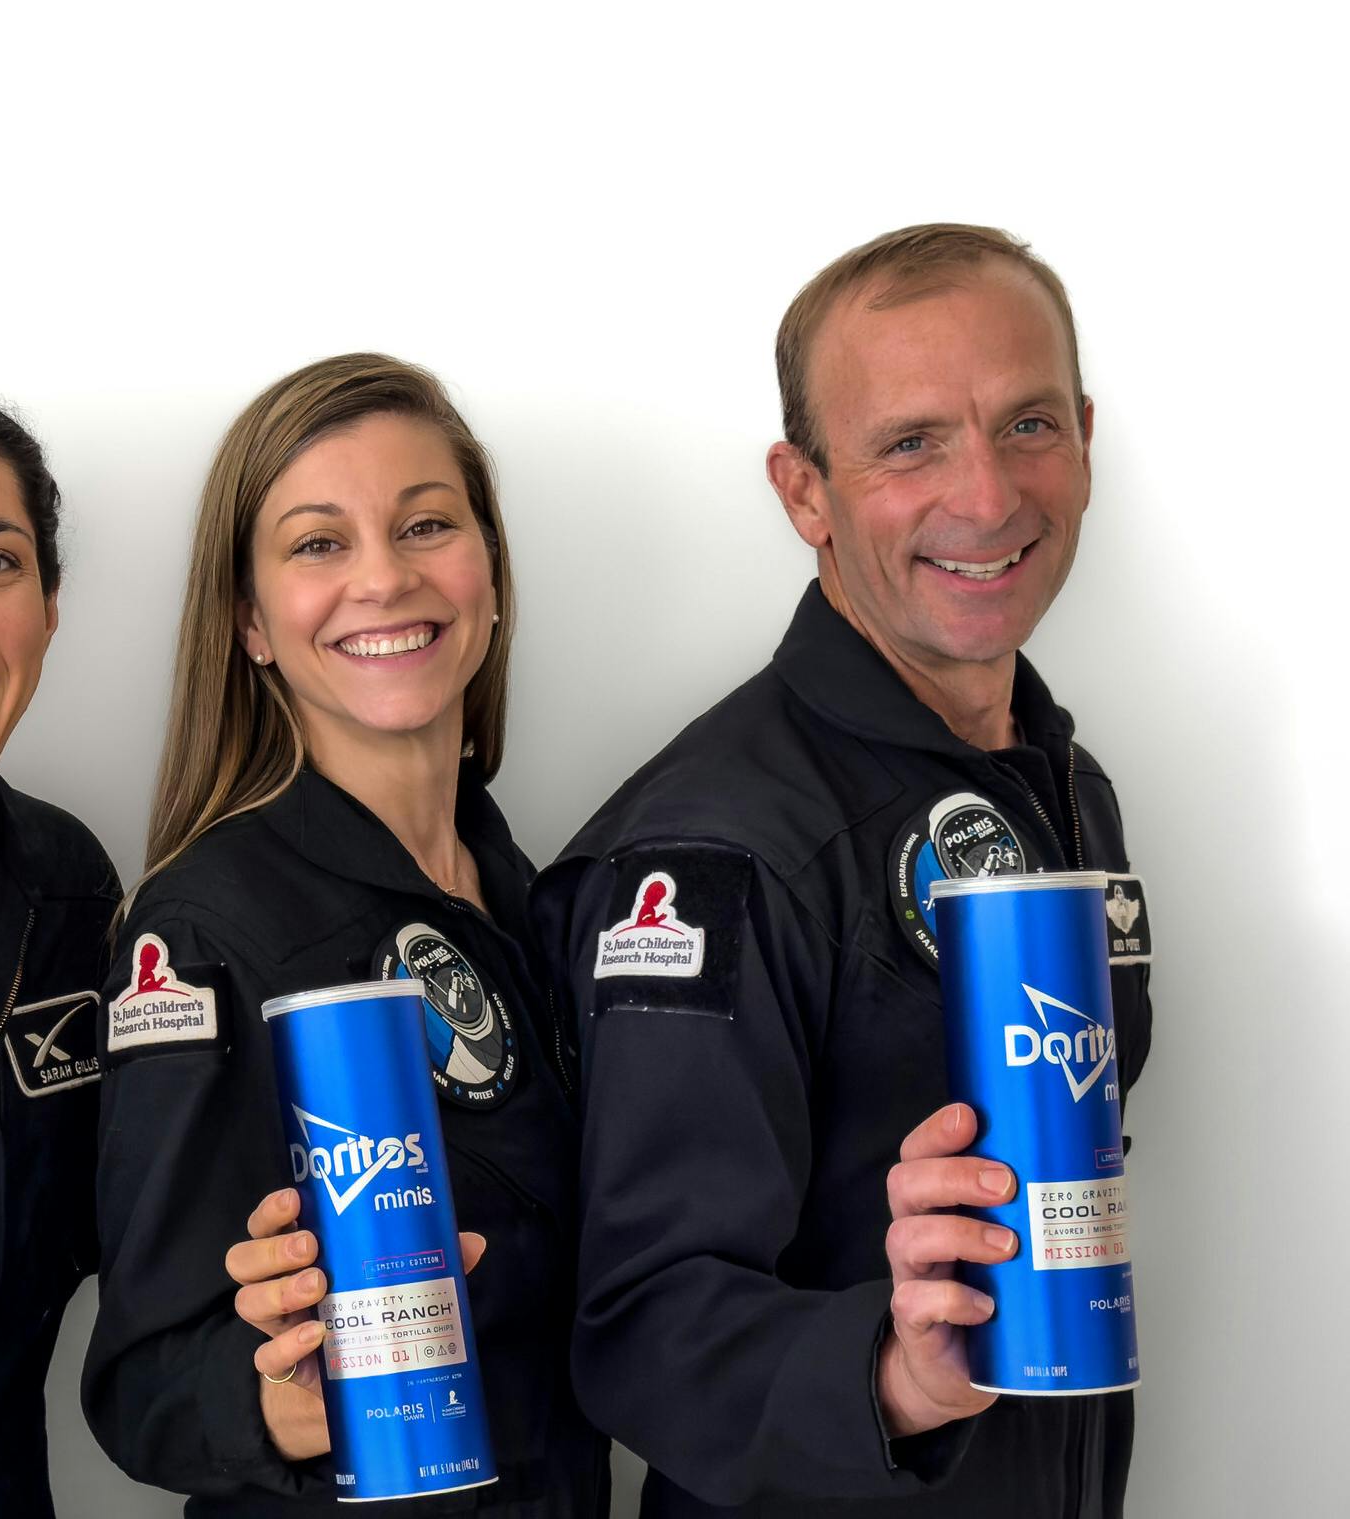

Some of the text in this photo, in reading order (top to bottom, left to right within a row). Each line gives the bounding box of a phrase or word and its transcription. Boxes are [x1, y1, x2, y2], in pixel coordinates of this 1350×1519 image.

[943, 816, 994, 849] POLARIS
[612, 938, 636, 953] Jude
[637, 937, 695, 950] Children's
[915, 928, 940, 960] ISAAC
[601, 952, 692, 967] Research Hospital
[122, 1006, 142, 1023] Jude
[143, 999, 204, 1016] Children's
[113, 1014, 205, 1037] Research Hospital
[1004, 1024, 1116, 1067] Dorito
[39, 1056, 100, 1084] SARAH GILLIS
[290, 1132, 426, 1183] Doritos
[1041, 1191, 1073, 1202] ZERO
[1042, 1204, 1101, 1219] COOL
[1043, 1227, 1084, 1236] FLAVORED
[1045, 1244, 1107, 1260] MISSION
[409, 1255, 440, 1267] EDITION
[351, 1295, 405, 1311] GRAVITY
[1090, 1295, 1131, 1311] POLARIS
[325, 1314, 373, 1330] COOL
[390, 1327, 432, 1339] TORTILLA
[433, 1324, 454, 1334] CHIPS
[392, 1350, 411, 1364] 01
[1051, 1366, 1068, 1377] CHIPS
[366, 1402, 425, 1420] POLARIS
[403, 1413, 425, 1422] DAWN
